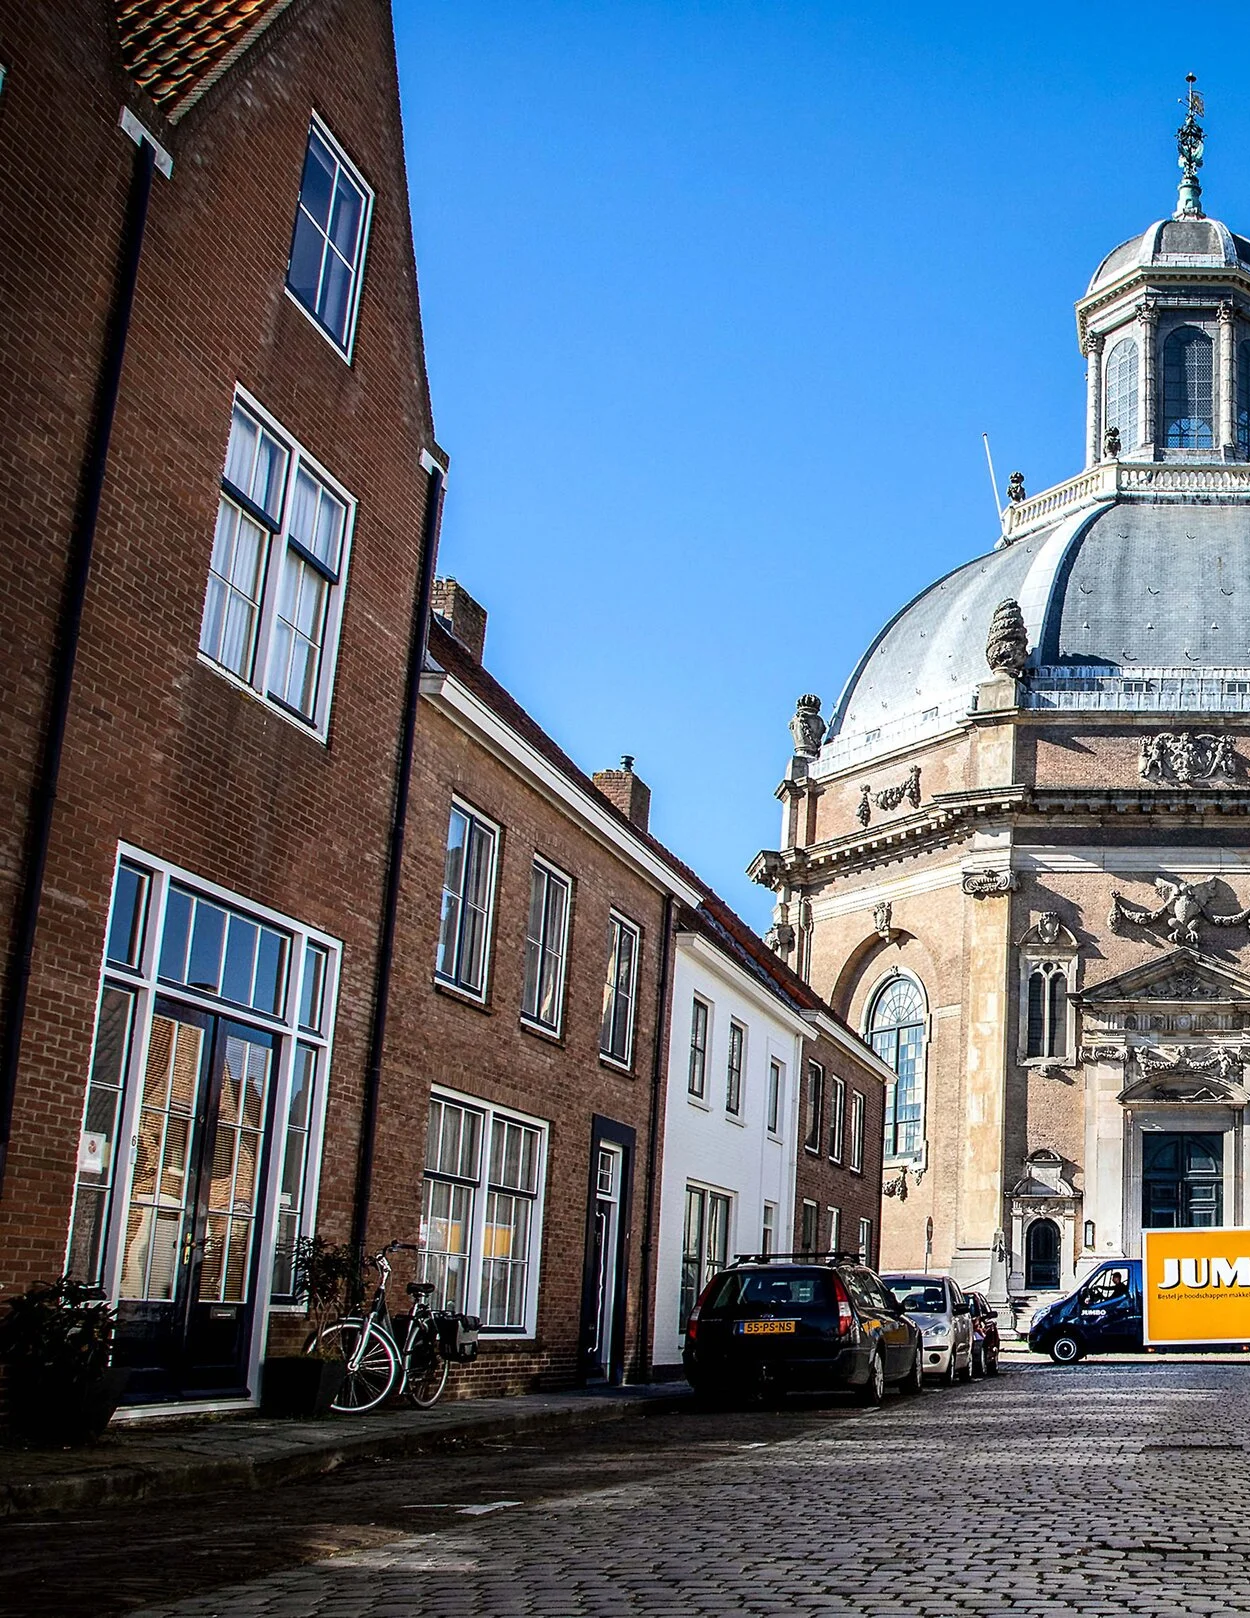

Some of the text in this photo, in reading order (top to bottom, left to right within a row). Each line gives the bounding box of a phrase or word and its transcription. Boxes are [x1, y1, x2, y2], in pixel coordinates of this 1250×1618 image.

[131, 1135, 137, 1147] 6
[1184, 1292, 1229, 1300] boodschappen
[746, 1322, 792, 1333] 55-PS-NS
